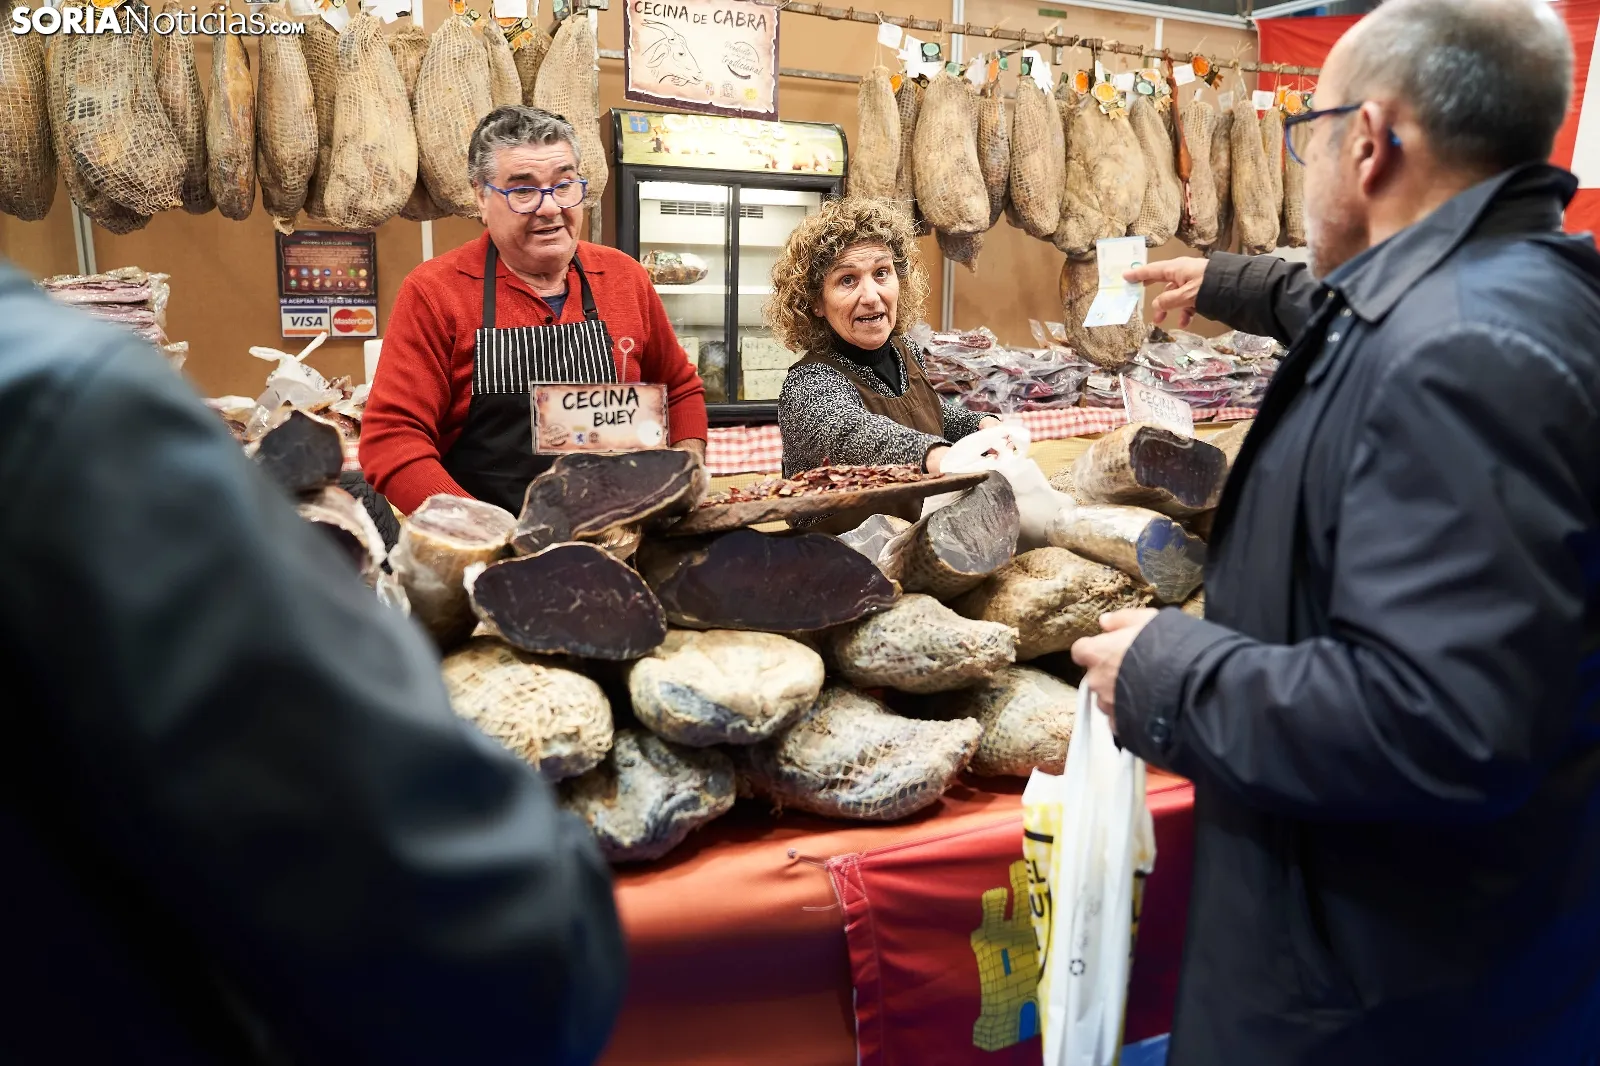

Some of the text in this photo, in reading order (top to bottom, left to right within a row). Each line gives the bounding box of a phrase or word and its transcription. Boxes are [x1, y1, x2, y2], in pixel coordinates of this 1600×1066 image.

[634, 0, 689, 22] CECINA
[713, 10, 768, 32] CABRA
[291, 316, 323, 327] VISA
[563, 387, 640, 410] CECINA
[1139, 390, 1178, 414] CECINA
[594, 409, 636, 428] BUEY
